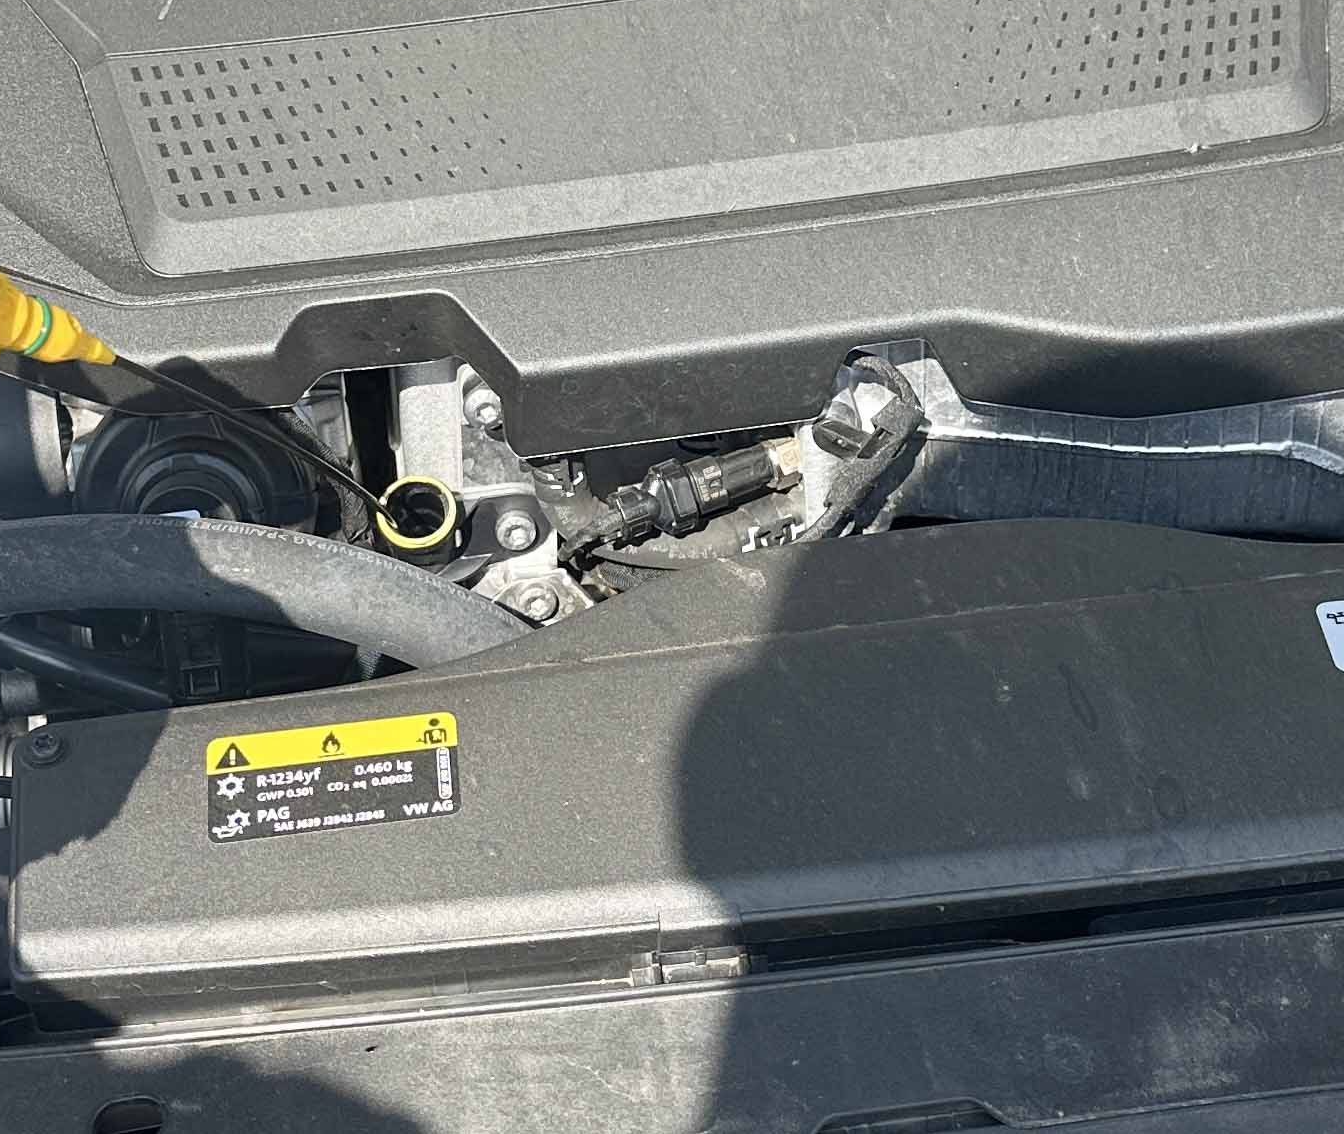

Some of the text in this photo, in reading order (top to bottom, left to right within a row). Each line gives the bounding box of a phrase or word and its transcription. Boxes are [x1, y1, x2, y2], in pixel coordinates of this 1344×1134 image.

[256, 759, 413, 788] R-1234yf 0.460 kg
[256, 789, 285, 802] GWP
[286, 786, 314, 798] 0.501
[352, 780, 367, 791] eq
[257, 800, 454, 823] PAG VW AG
[273, 821, 294, 833] SAE
